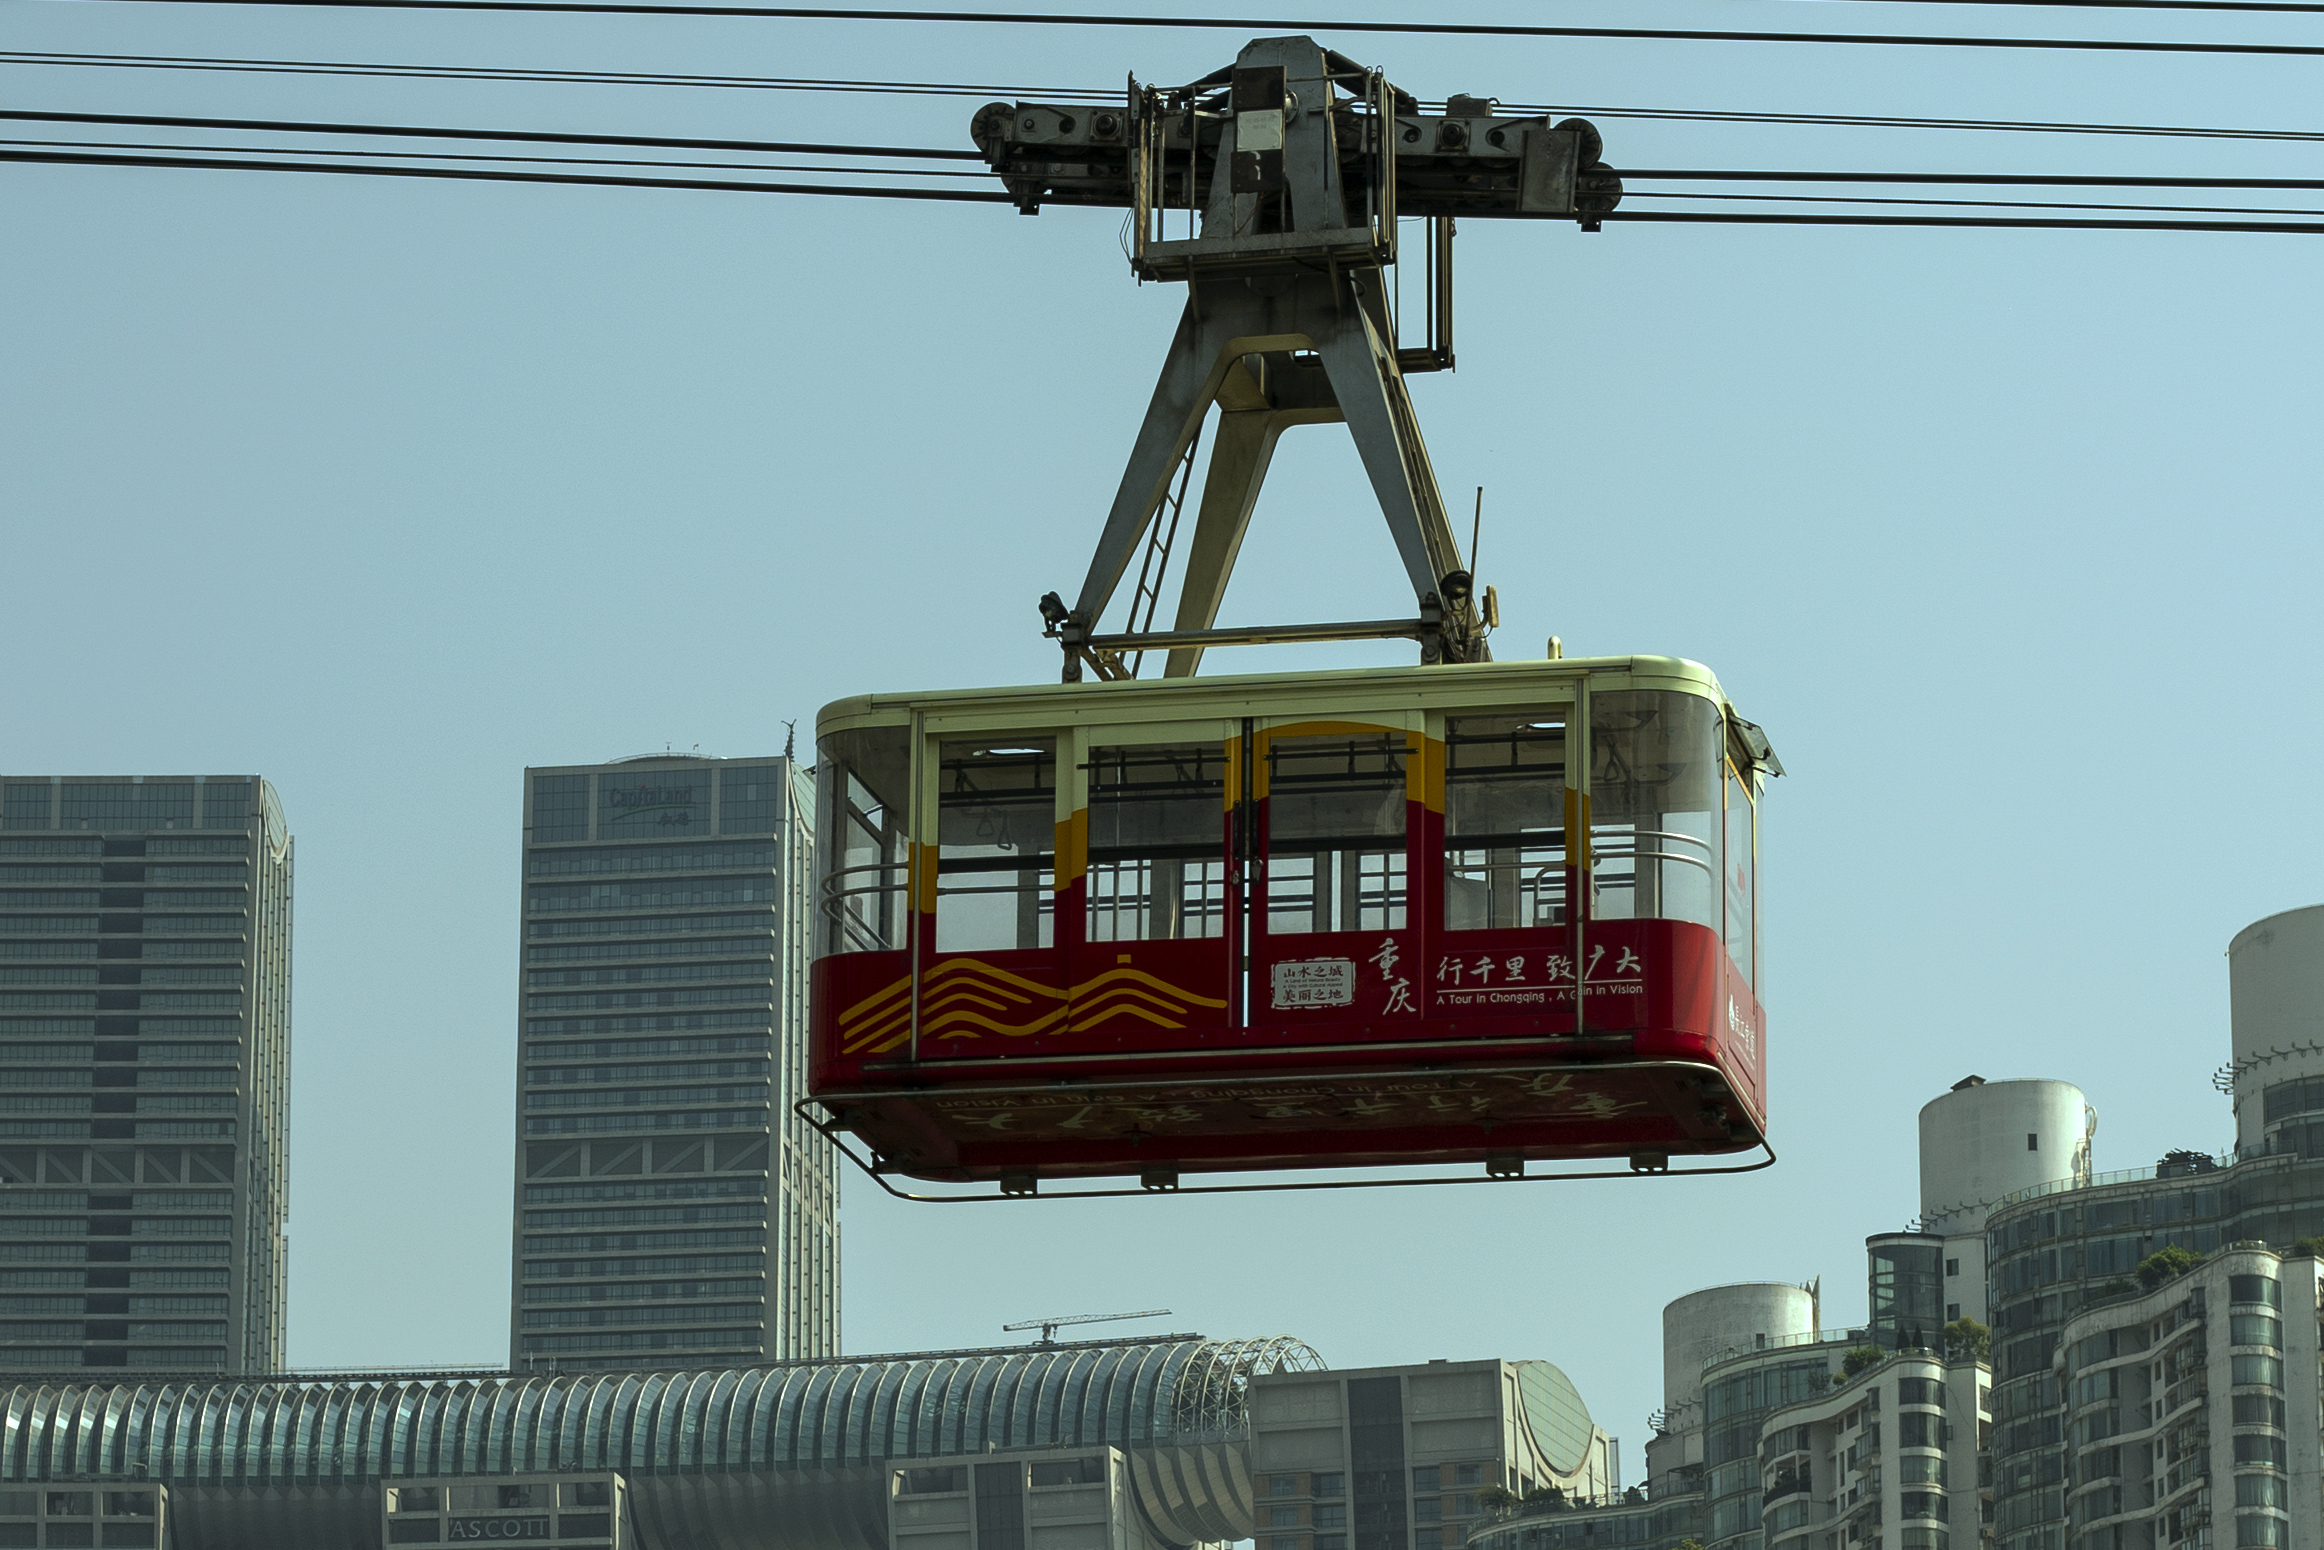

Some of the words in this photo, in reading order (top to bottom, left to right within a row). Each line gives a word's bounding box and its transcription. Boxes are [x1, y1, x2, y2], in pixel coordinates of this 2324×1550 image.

[1283, 965, 1344, 978] 山水之城
[1368, 937, 1417, 1016] 重庆
[1436, 955, 1526, 986] 行千里
[1283, 989, 1344, 1003] 美丽之地
[1436, 995, 1445, 1005] A
[1449, 994, 1472, 1004] Tour
[1557, 991, 1566, 1001] A
[1610, 984, 1643, 995] Vision
[451, 1518, 548, 1539] ASCOTT
